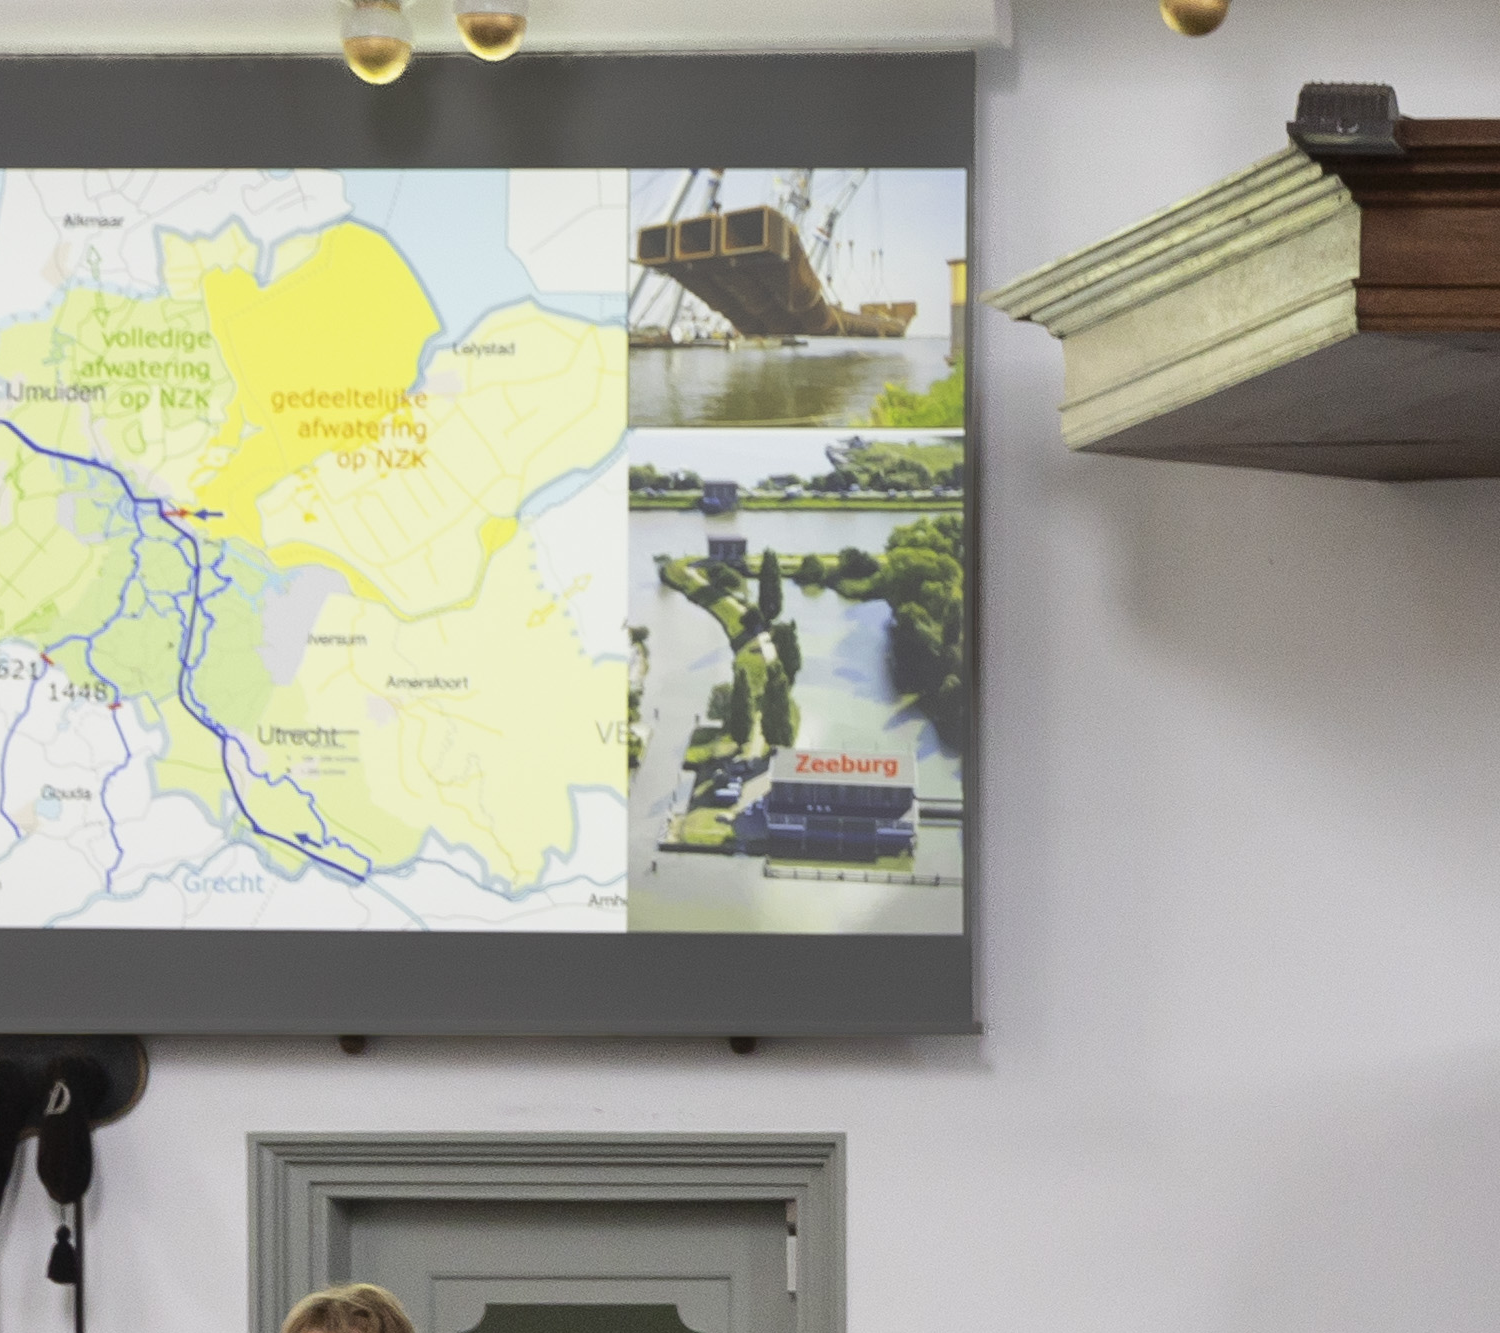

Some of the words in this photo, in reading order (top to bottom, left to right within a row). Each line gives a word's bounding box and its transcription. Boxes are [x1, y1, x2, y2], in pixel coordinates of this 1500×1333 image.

[63, 213, 124, 228] Alkmaar
[103, 327, 211, 351] volledige
[80, 358, 211, 381] afwatering
[5, 382, 106, 402] IJmuiden
[119, 390, 152, 411] op
[160, 388, 211, 409] NZK
[270, 387, 429, 413] gedeeltelijke
[297, 418, 428, 442] afwatering
[335, 450, 367, 471] op
[376, 449, 428, 469] NZK
[50, 682, 109, 702] 1448
[257, 725, 342, 749] Utrecht
[796, 753, 898, 778] Zeeburg
